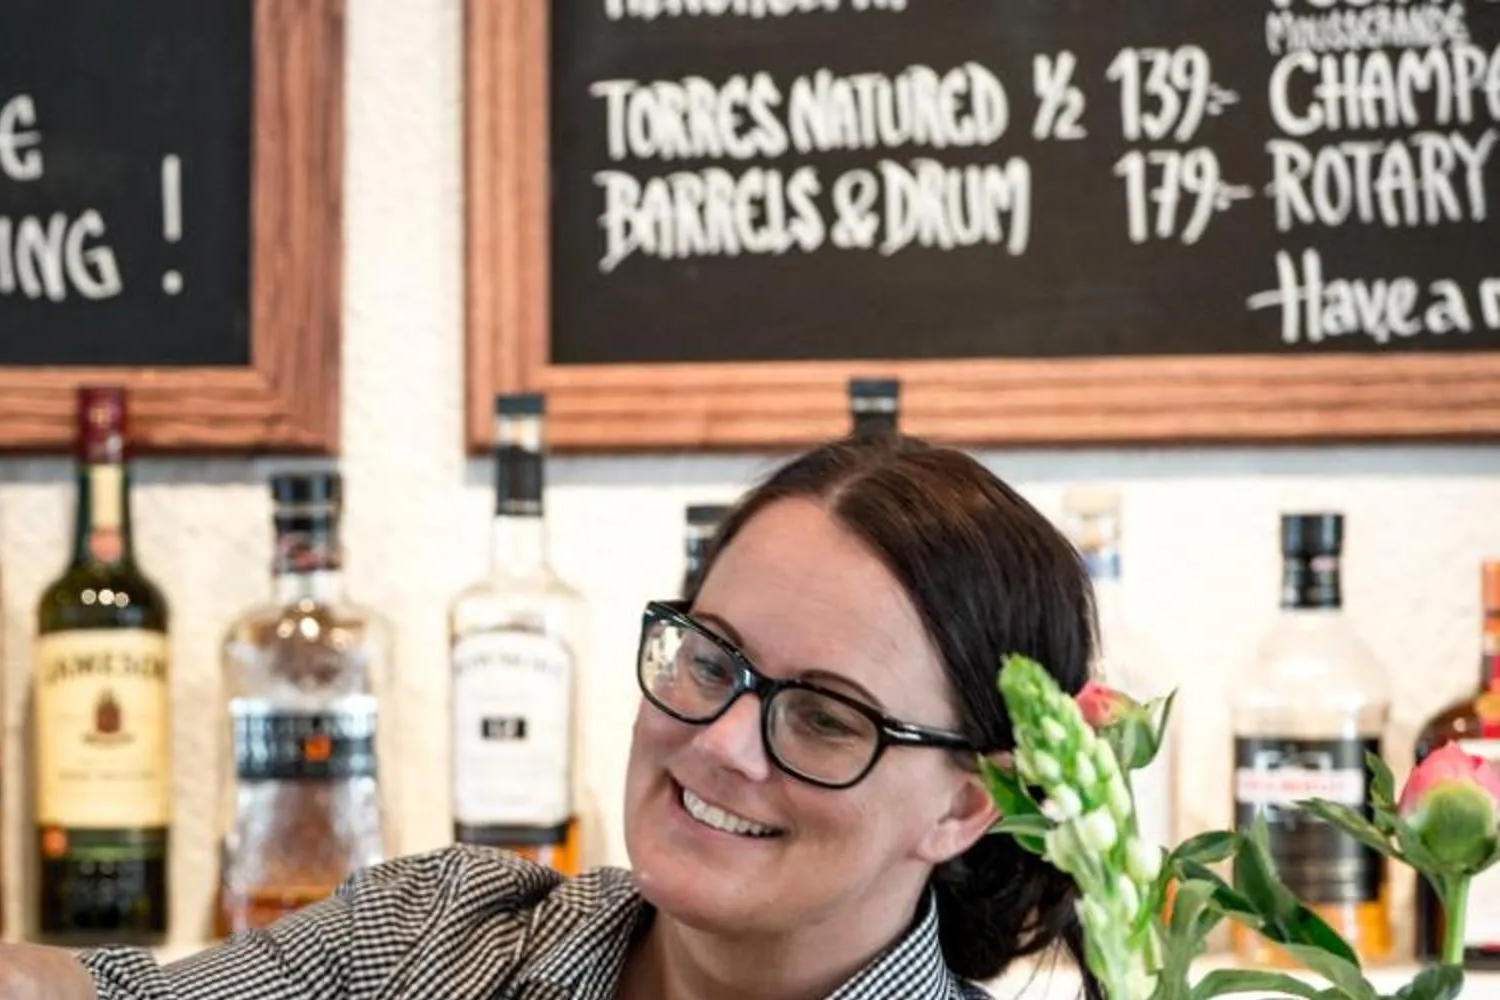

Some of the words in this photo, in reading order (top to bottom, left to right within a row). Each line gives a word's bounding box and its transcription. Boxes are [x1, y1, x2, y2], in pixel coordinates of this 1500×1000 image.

[590, 71, 788, 160] TORRES
[787, 61, 1009, 153] NATURED
[593, 164, 826, 273] BARRELS
[831, 167, 881, 249] &
[878, 156, 1032, 257] DRUM
[1264, 130, 1500, 232] ROTARY
[1246, 247, 1424, 345] Have
[1425, 278, 1473, 334] a
